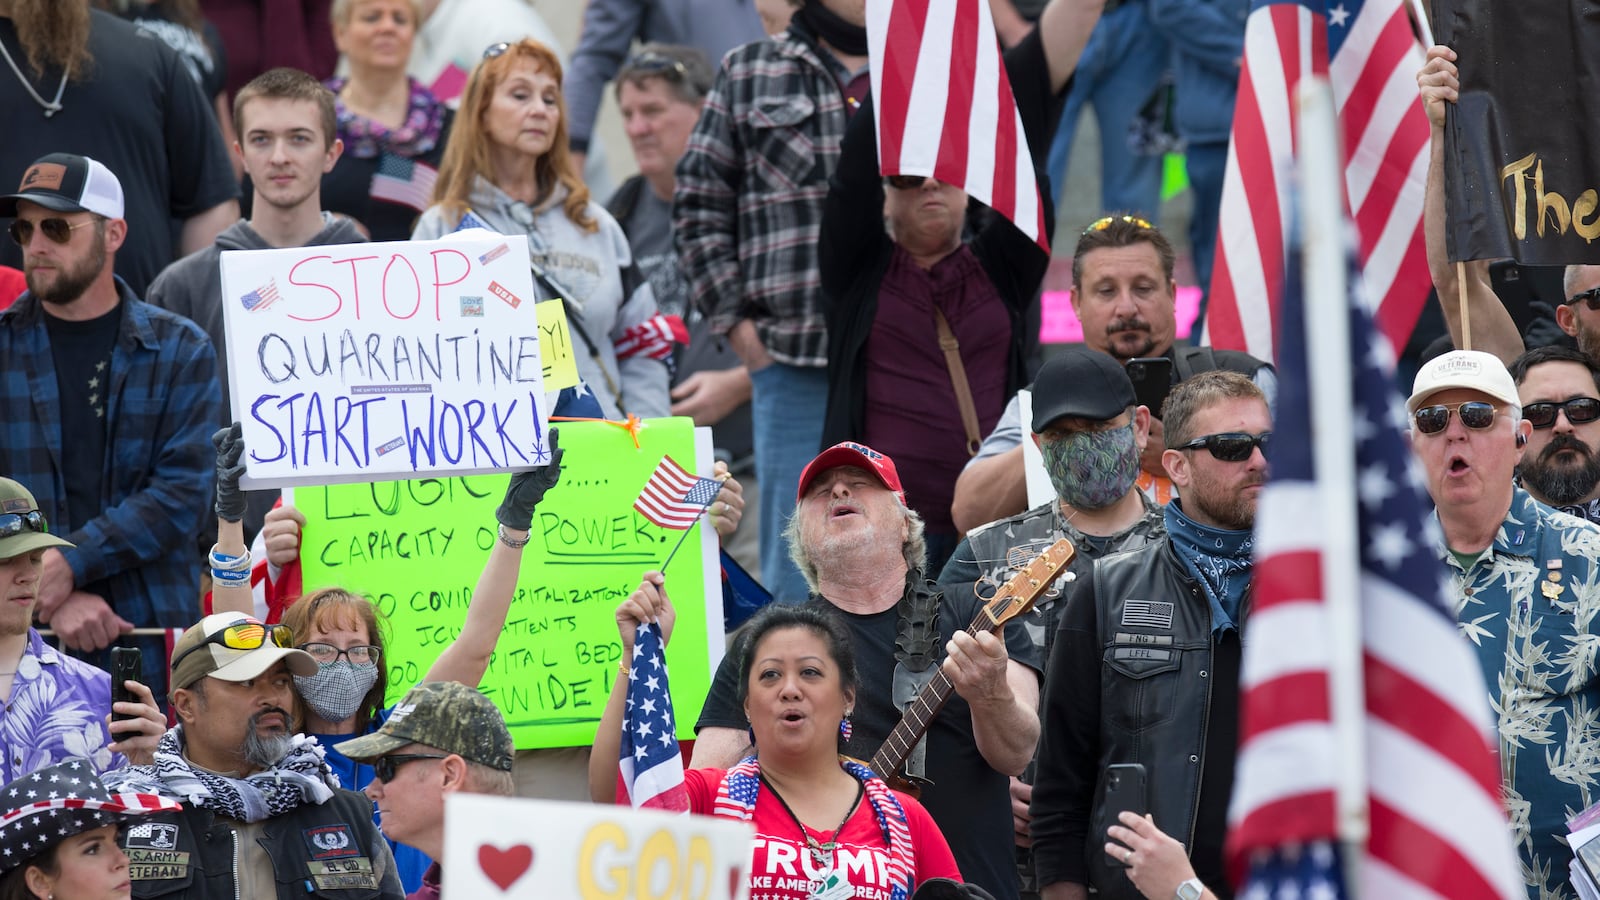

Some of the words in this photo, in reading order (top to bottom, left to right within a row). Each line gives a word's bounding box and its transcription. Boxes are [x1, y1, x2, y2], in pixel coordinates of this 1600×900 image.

[1501, 152, 1600, 244] The
[288, 249, 471, 322] STOP
[540, 319, 566, 359] Y!
[250, 391, 387, 470] START
[403, 391, 552, 472] WORK!
[320, 527, 455, 567] CAPACITY
[409, 587, 472, 612] COVID
[501, 615, 577, 636] ATIENTS
[489, 648, 558, 675] PITAL
[128, 866, 180, 878] ETERAN
[577, 820, 714, 900] GOD
[744, 876, 773, 889] AKE
